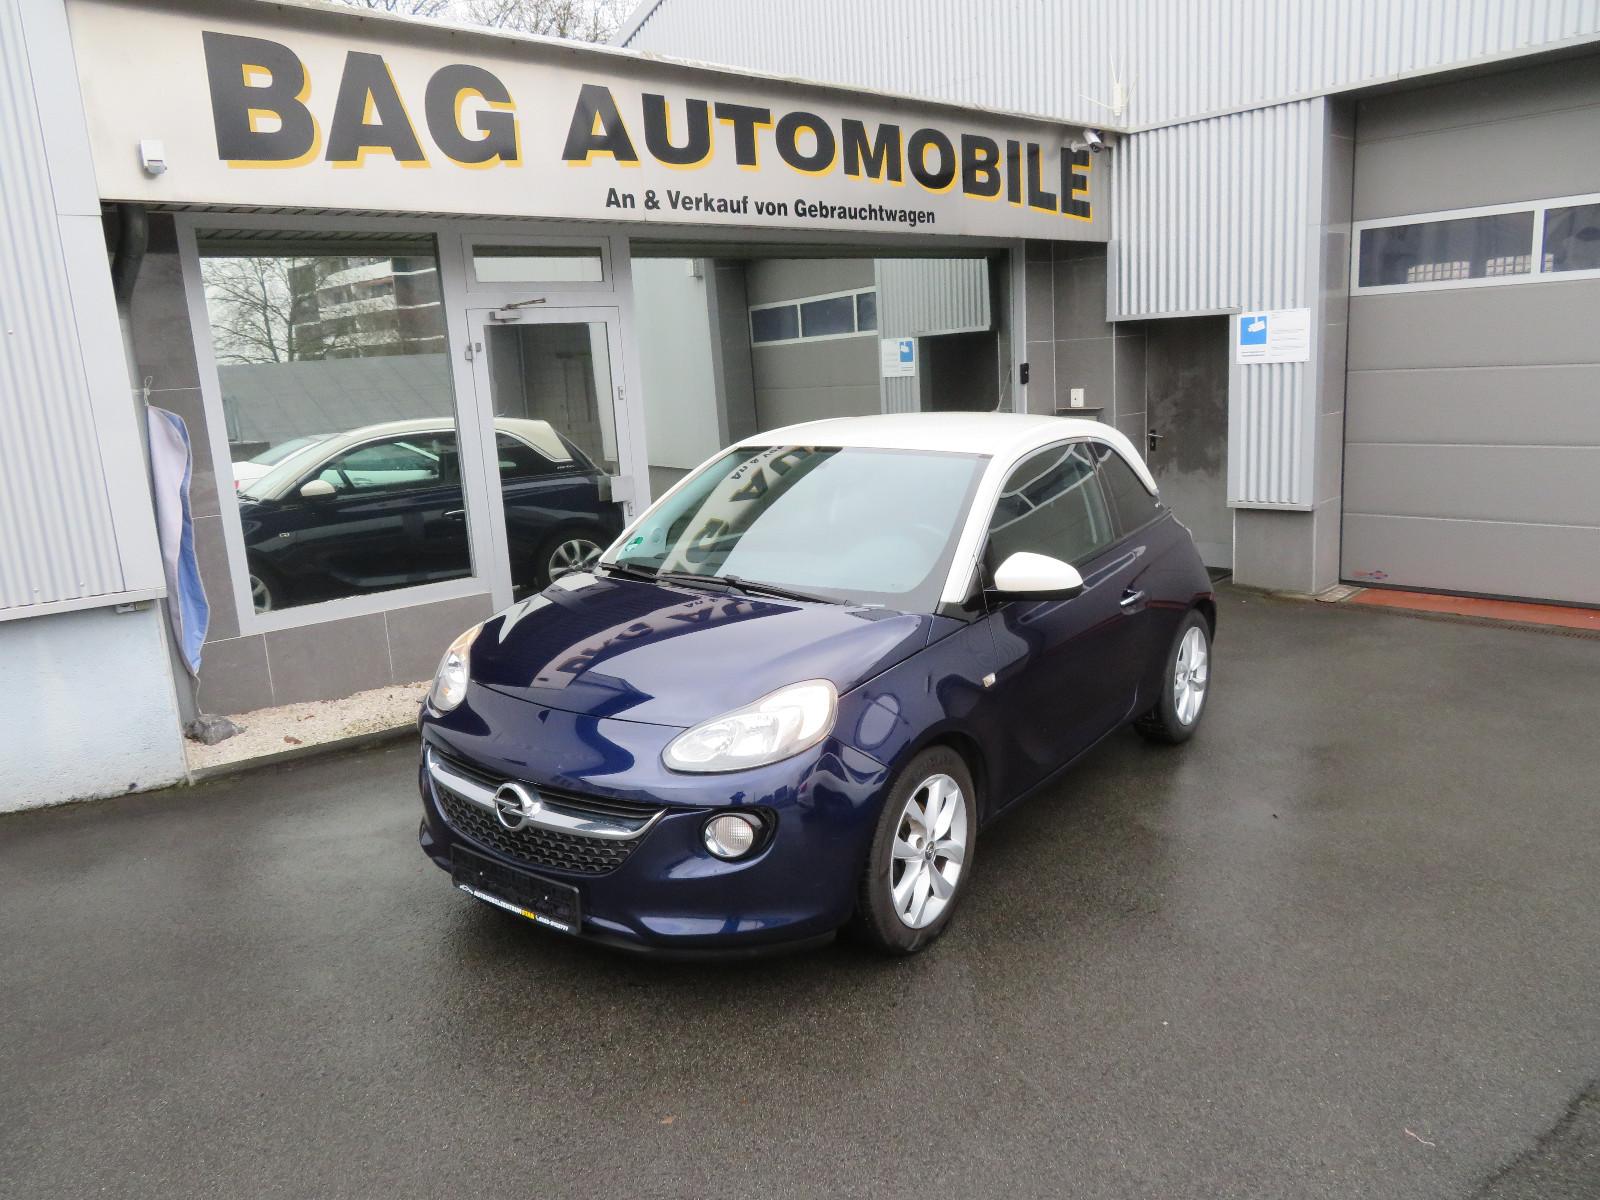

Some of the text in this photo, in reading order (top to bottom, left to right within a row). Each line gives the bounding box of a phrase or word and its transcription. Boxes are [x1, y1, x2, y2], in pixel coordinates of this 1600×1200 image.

[202, 30, 1093, 223] BAG AUTOMOBILE
[605, 187, 936, 228] An & Verkauf von Gebrauchtwagen
